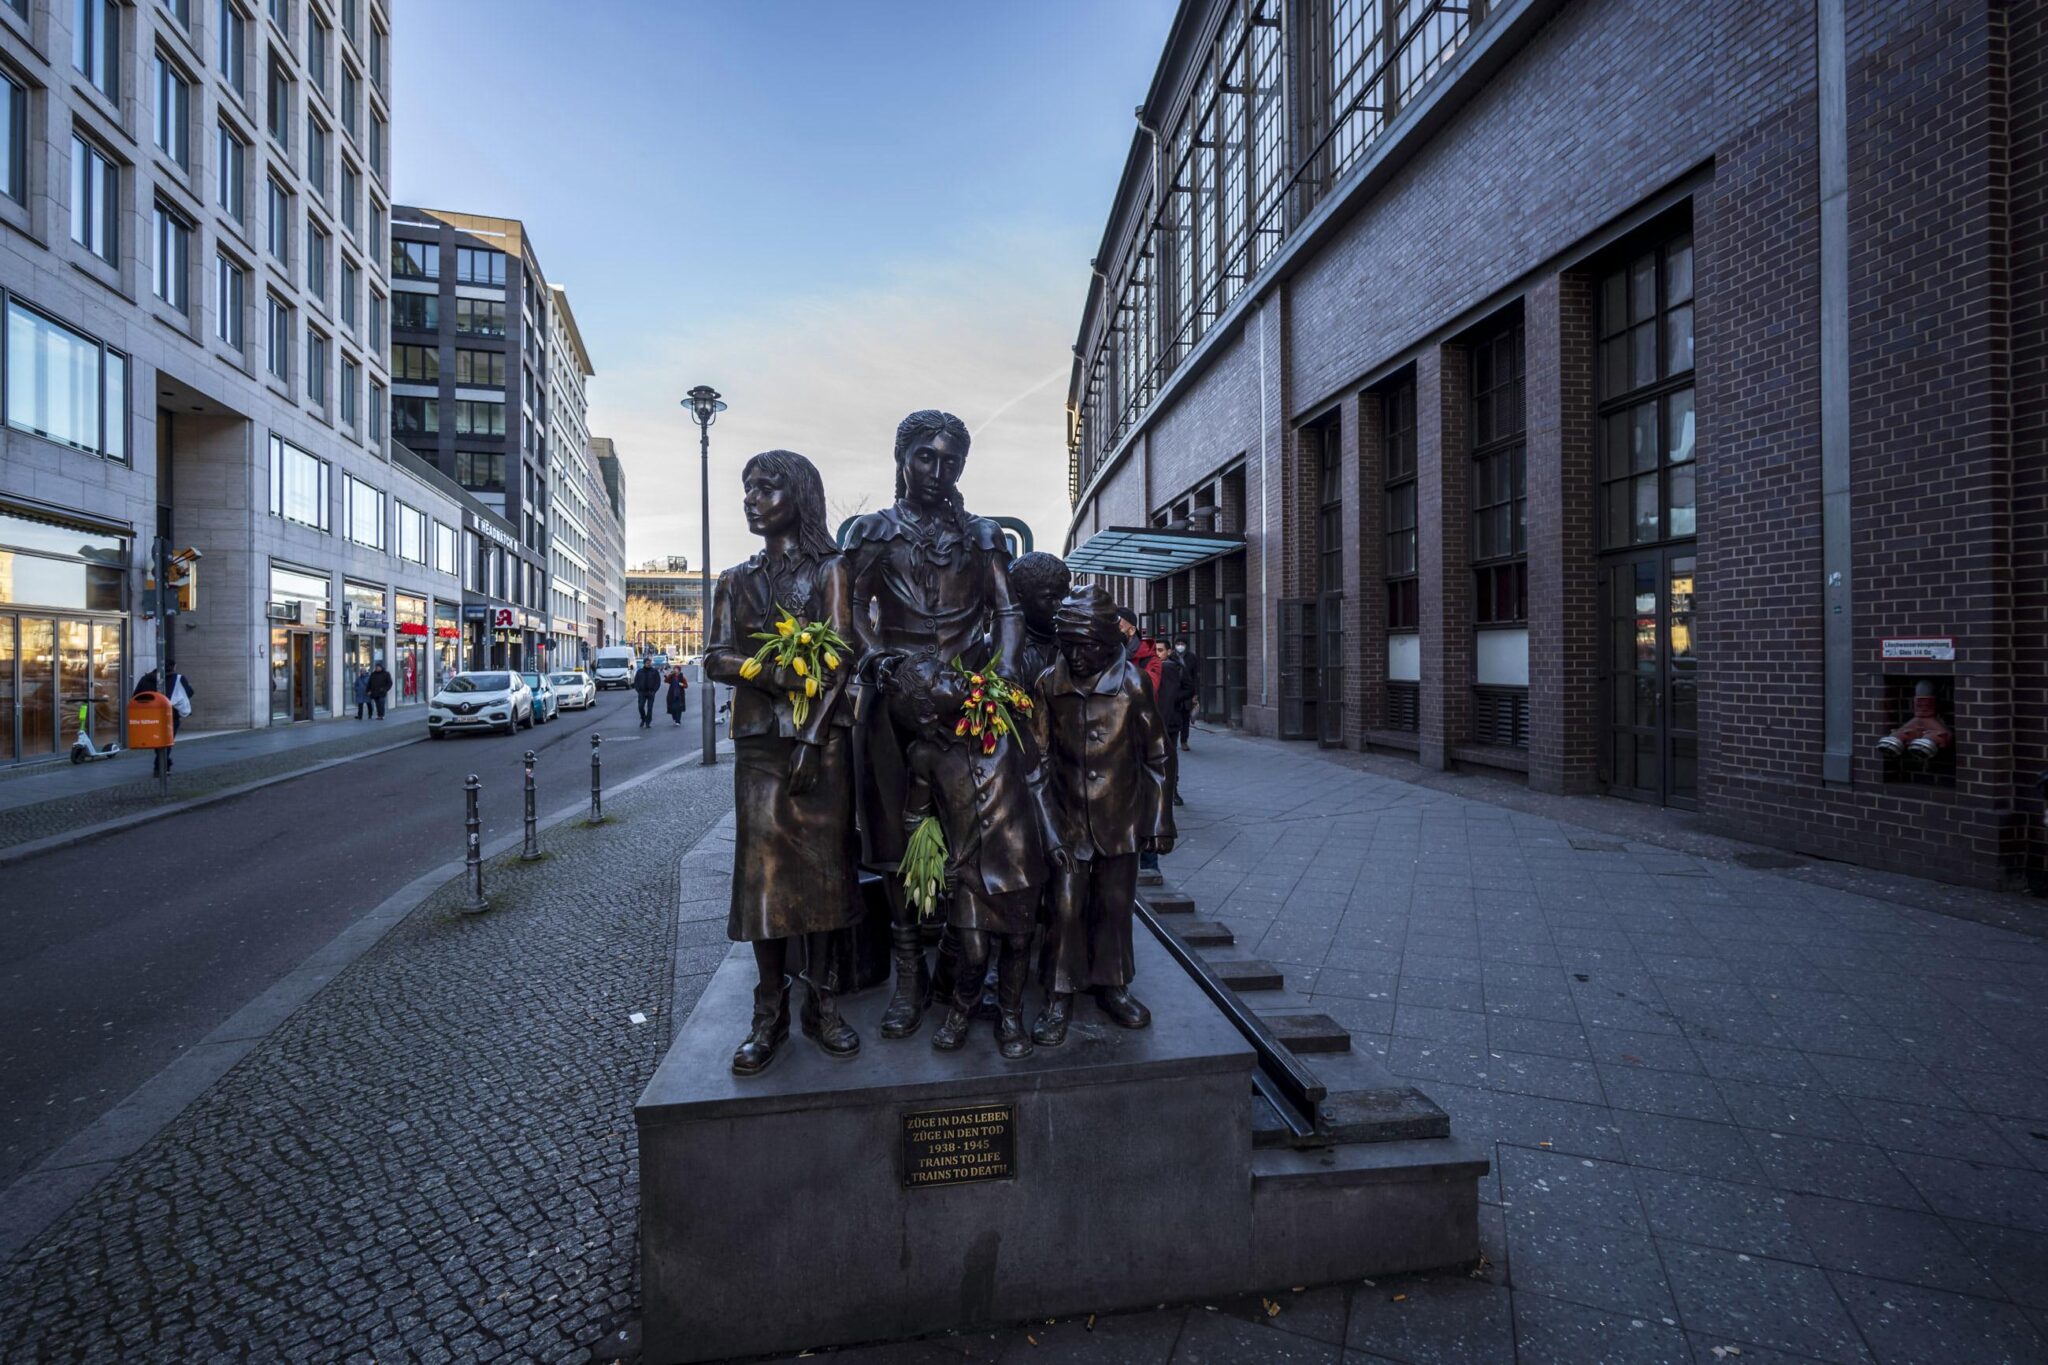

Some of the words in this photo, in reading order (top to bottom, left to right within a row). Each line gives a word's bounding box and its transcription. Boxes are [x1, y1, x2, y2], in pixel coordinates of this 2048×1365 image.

[907, 1116, 936, 1129] ZÜGE
[938, 1116, 950, 1126] IN
[951, 1114, 973, 1125] DAS
[974, 1111, 1009, 1123] LEBEN
[912, 1130, 942, 1142] ZÜGE
[944, 1129, 955, 1139] IN
[957, 1127, 979, 1138] DEN
[981, 1124, 1004, 1136] TOD
[929, 1142, 955, 1153] 1938
[963, 1139, 990, 1150] 1945
[919, 1155, 959, 1168] TRAINS
[960, 1153, 975, 1164] TO
[977, 1151, 1001, 1163] LIFE
[911, 1169, 951, 1182] TRAINS
[953, 1168, 969, 1178] TO
[970, 1164, 1008, 1177] DEATH
